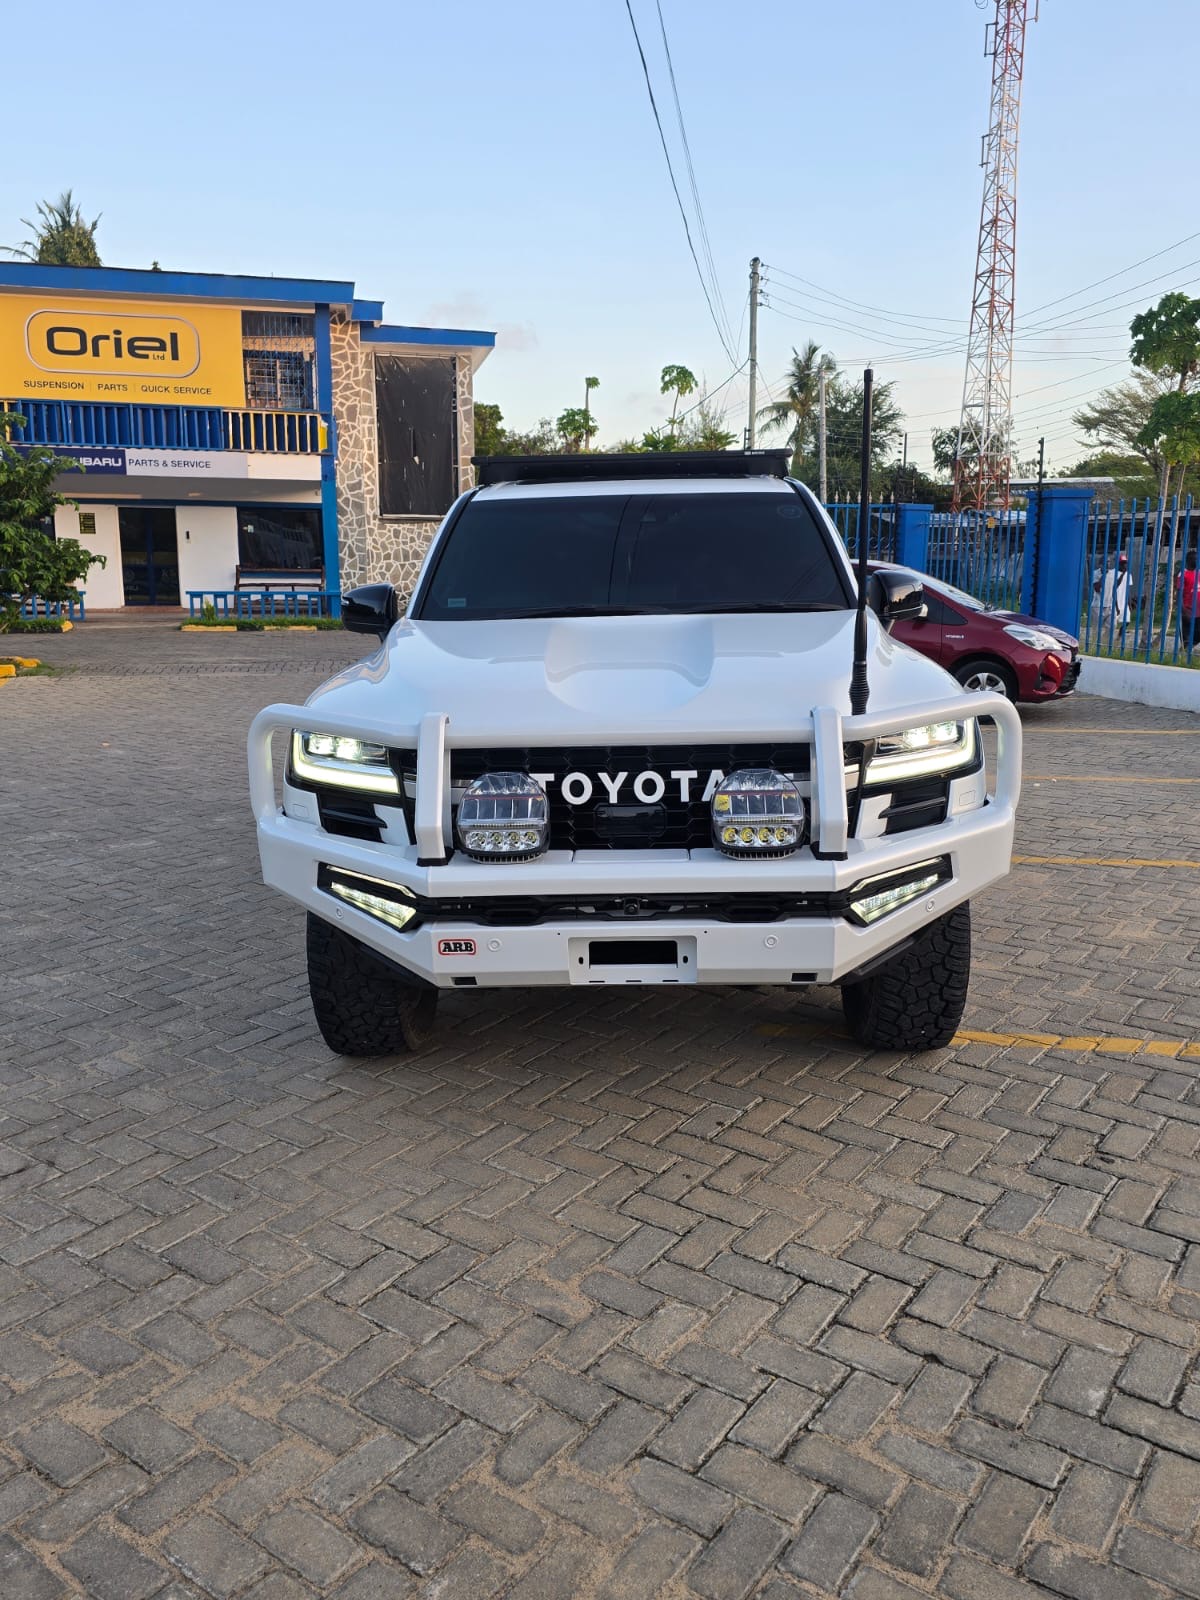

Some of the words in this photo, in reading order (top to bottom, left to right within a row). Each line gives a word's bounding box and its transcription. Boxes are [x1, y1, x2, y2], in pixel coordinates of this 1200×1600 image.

[46, 326, 180, 361] Oriel
[23, 380, 85, 390] SUSPENSION
[97, 383, 128, 392] PARTS
[141, 384, 170, 393] QUICK
[173, 386, 212, 395] SERVICE
[128, 458, 160, 467] PARTS
[161, 459, 168, 468] &
[170, 460, 212, 469] SERVICE
[441, 941, 474, 953] ARB
